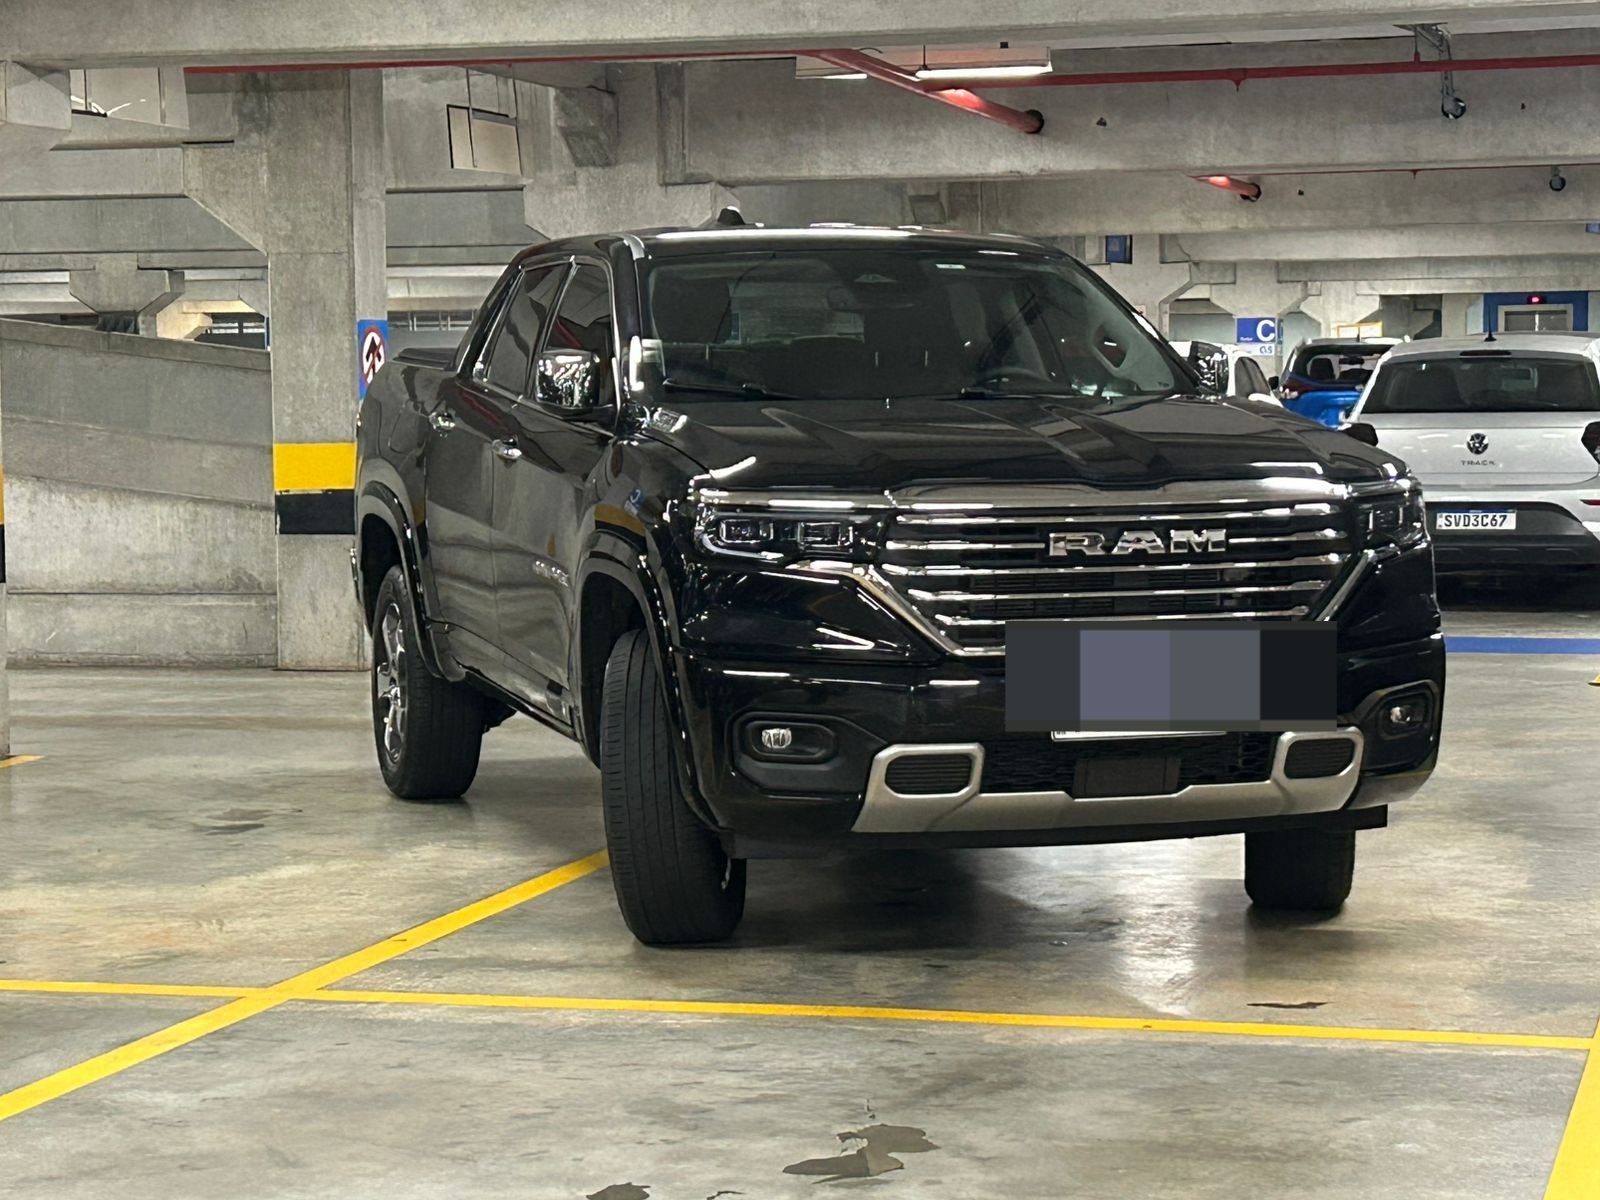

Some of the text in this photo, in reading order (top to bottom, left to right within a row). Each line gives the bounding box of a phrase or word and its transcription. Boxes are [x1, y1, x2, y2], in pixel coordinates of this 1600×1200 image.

[1256, 319, 1275, 342] C
[1443, 514, 1508, 528] SVD3C67
[1049, 529, 1226, 556] RAM
